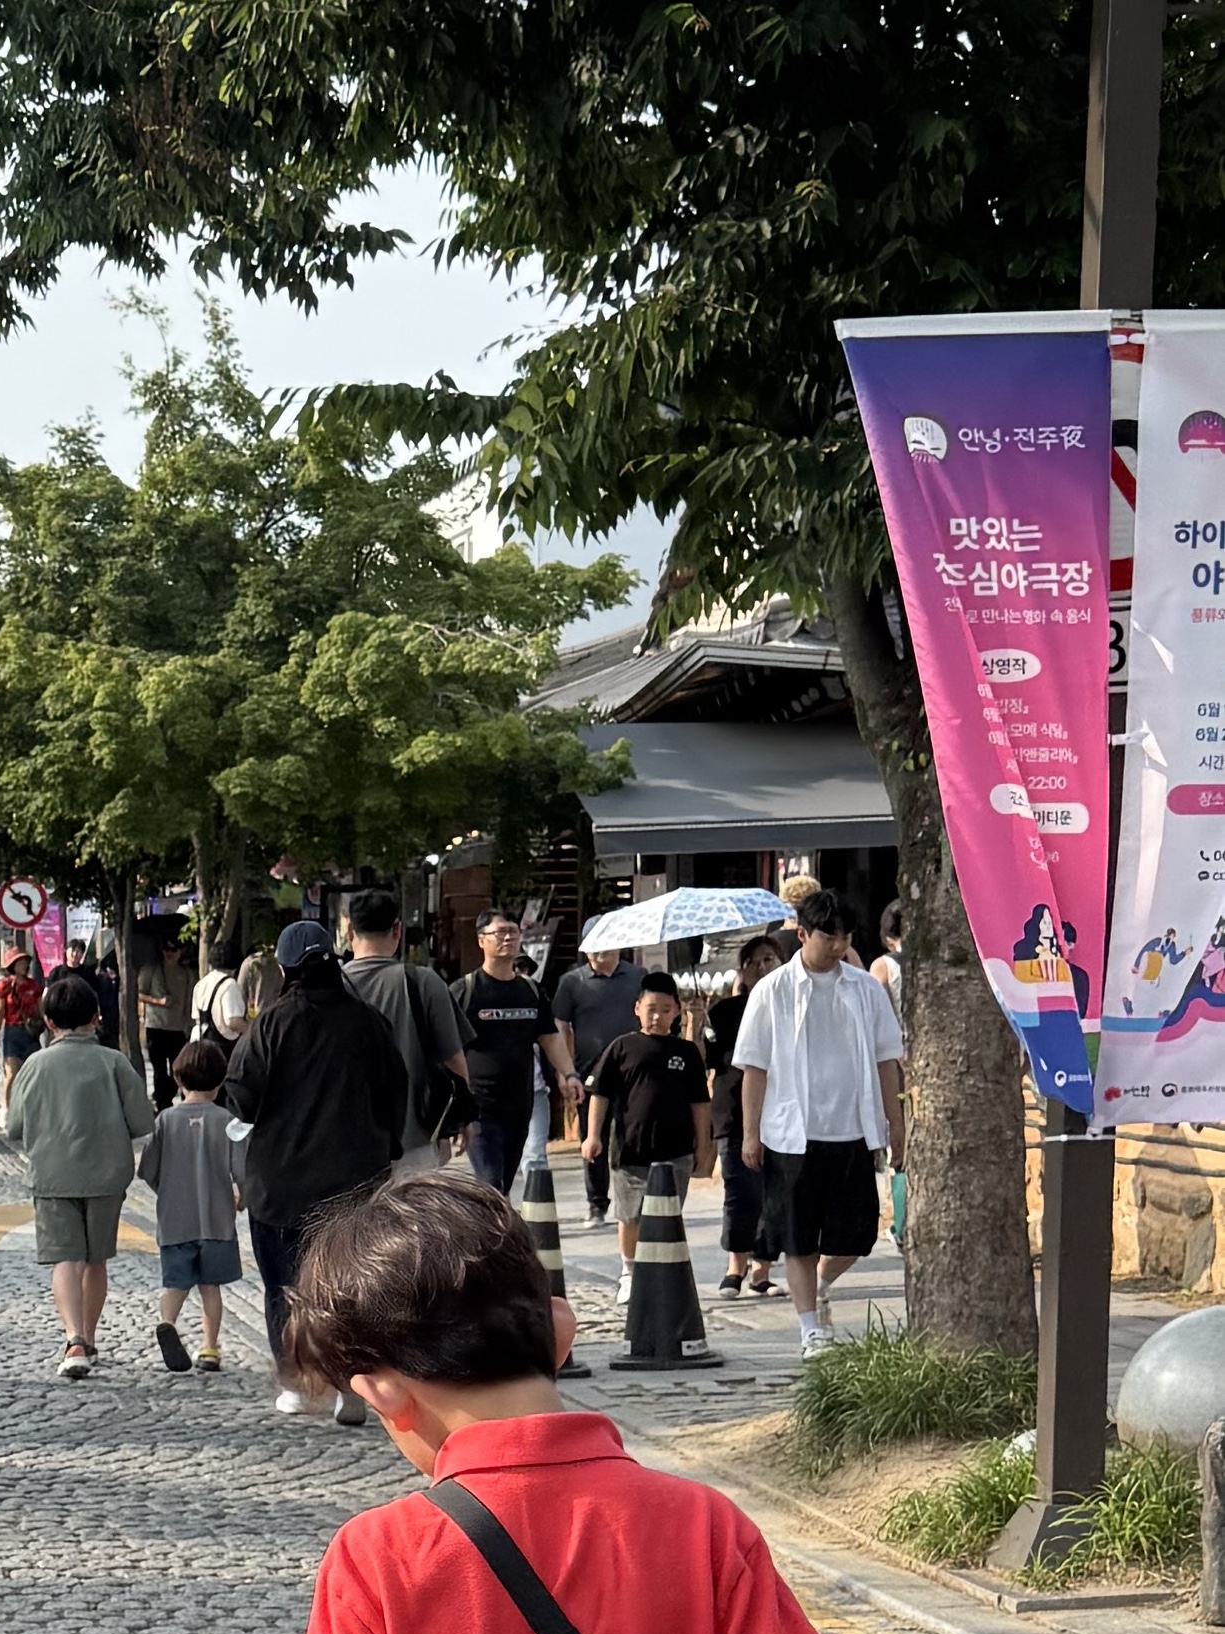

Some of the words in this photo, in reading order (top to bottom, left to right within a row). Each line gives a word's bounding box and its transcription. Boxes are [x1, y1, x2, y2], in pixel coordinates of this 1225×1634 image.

[949, 517, 1043, 552] 맛있는
[1174, 520, 1225, 549] 하이
[1192, 560, 1225, 595] 야
[1198, 703, 1220, 717] 6월
[1196, 727, 1218, 742] 6월
[1027, 775, 1067, 790] 22:00
